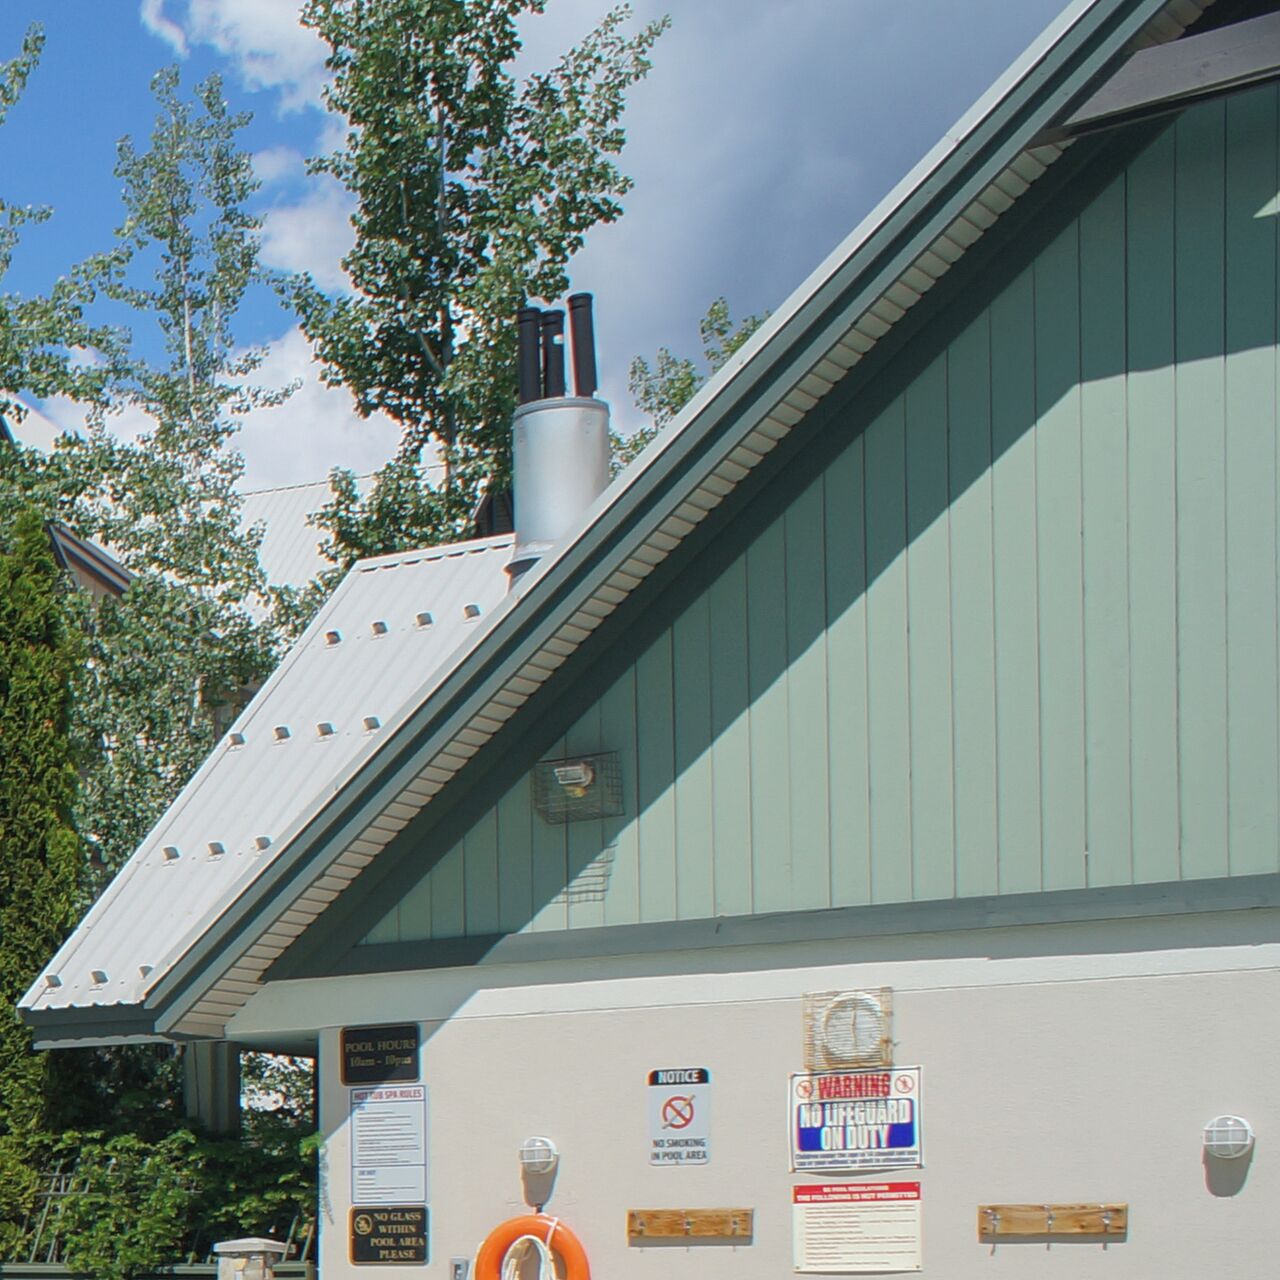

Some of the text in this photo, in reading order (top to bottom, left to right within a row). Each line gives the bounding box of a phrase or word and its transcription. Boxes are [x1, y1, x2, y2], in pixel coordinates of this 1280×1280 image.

[345, 1039, 416, 1053] POOL HOURS
[658, 1069, 700, 1083] NOTICE
[818, 1073, 891, 1099] WARNING
[800, 1099, 911, 1128] NO LIFEGUARD
[821, 1124, 889, 1151] ON DUTY
[652, 1138, 705, 1148] NO SMOKING
[651, 1150, 707, 1160] IN POOL AREA
[373, 1211, 421, 1221] NO GLASS
[378, 1224, 416, 1234] WITHIN
[370, 1237, 425, 1247] POOL AREA
[379, 1249, 416, 1259] PLEASE
